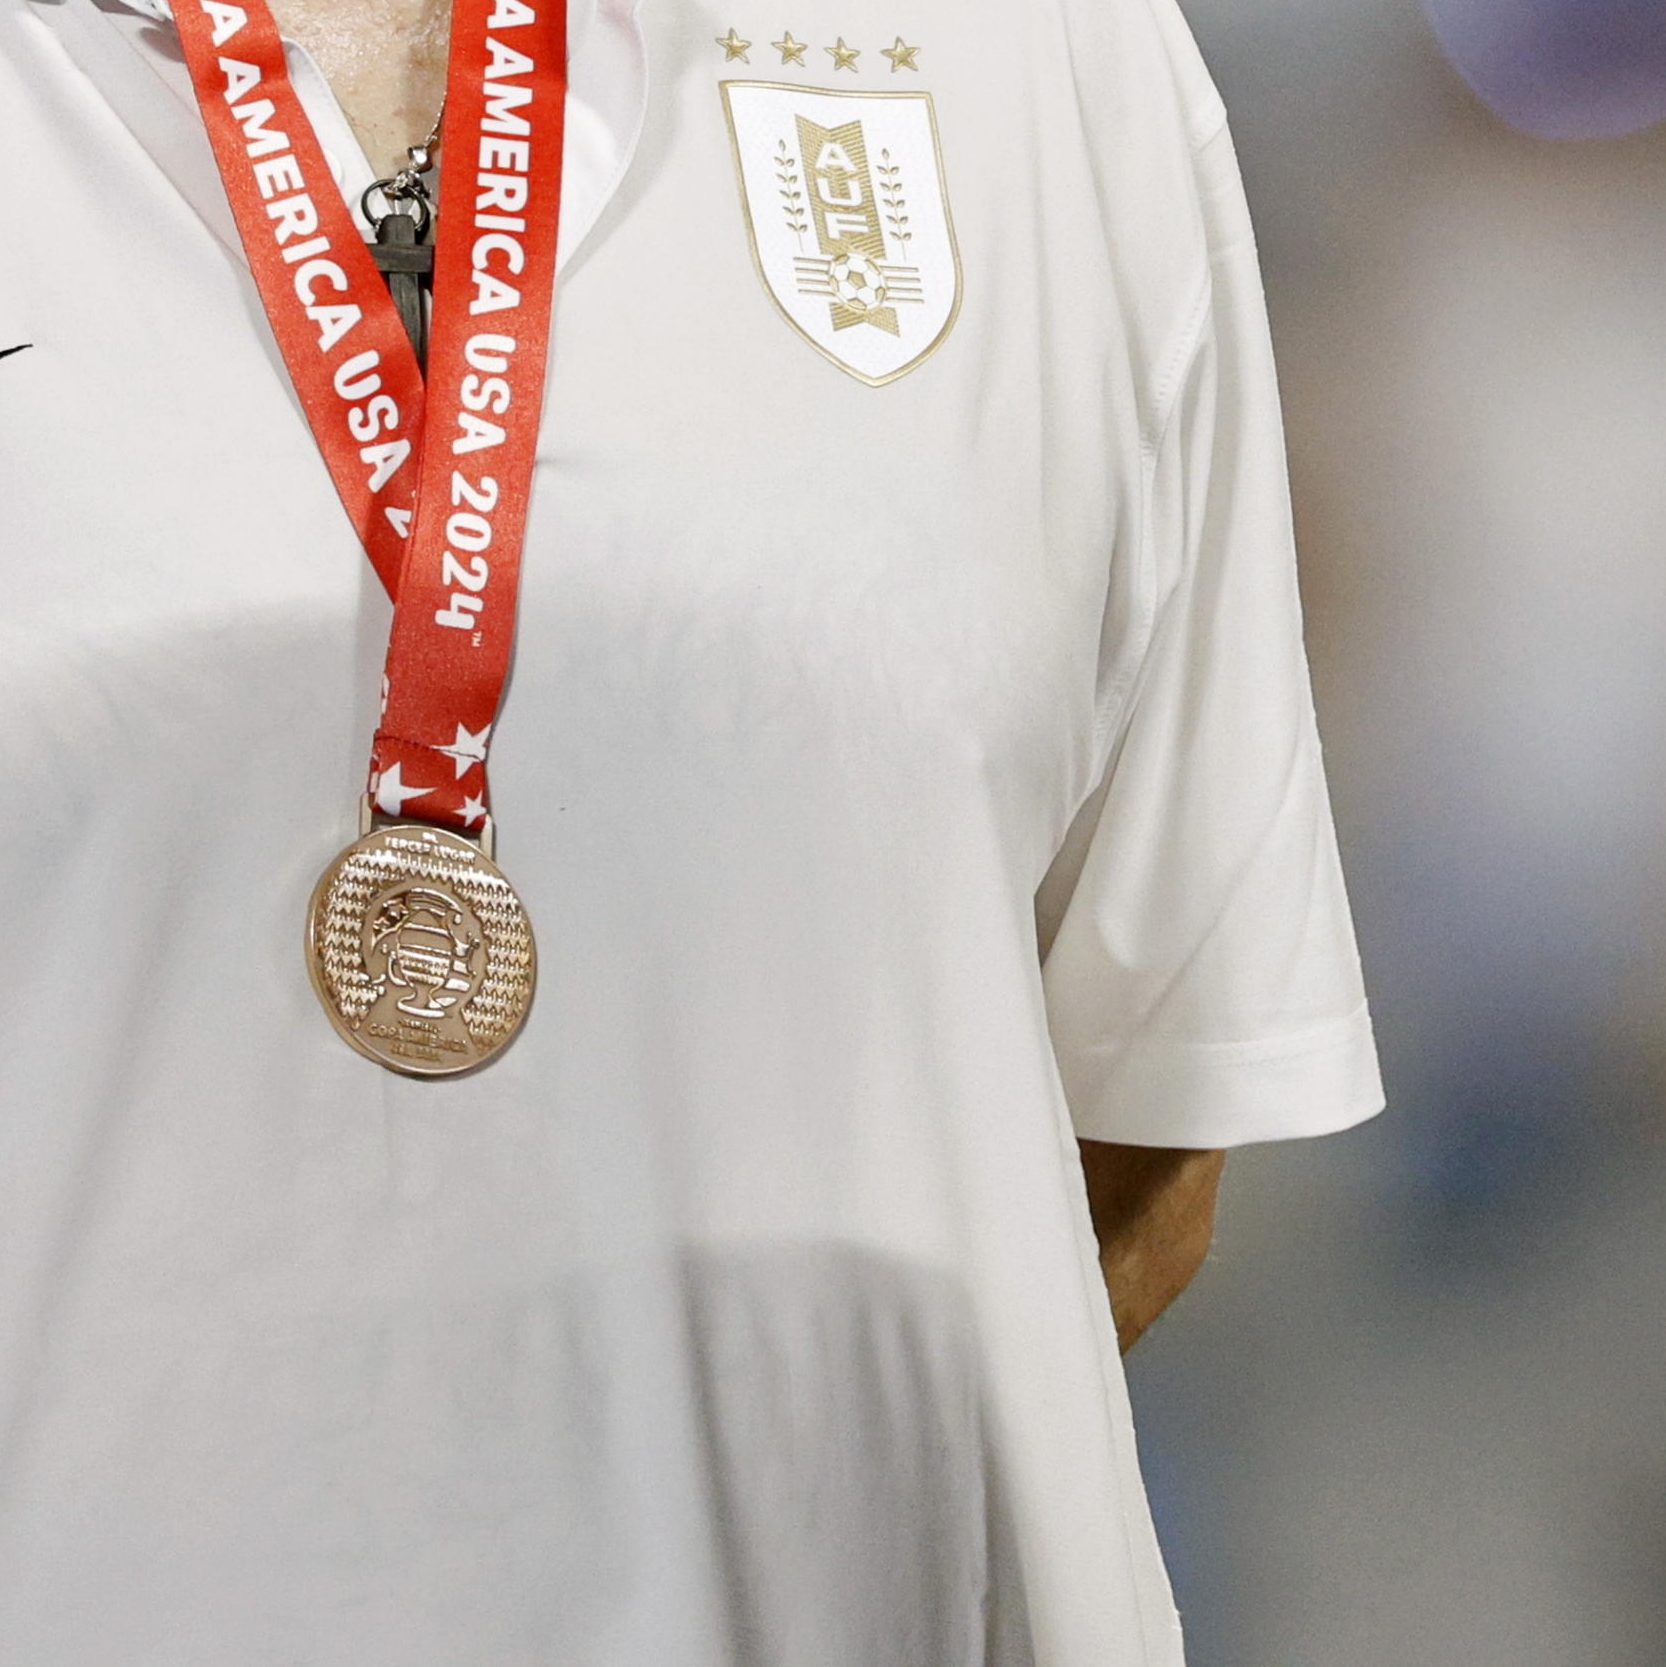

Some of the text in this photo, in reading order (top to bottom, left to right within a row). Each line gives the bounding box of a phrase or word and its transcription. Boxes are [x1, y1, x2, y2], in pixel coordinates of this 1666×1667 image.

[469, 38, 536, 316] AMERICA
[814, 142, 870, 241] AUF
[219, 56, 363, 352] AMERICA
[334, 350, 412, 493] USA
[452, 334, 516, 455] USA
[435, 471, 498, 629] 2024
